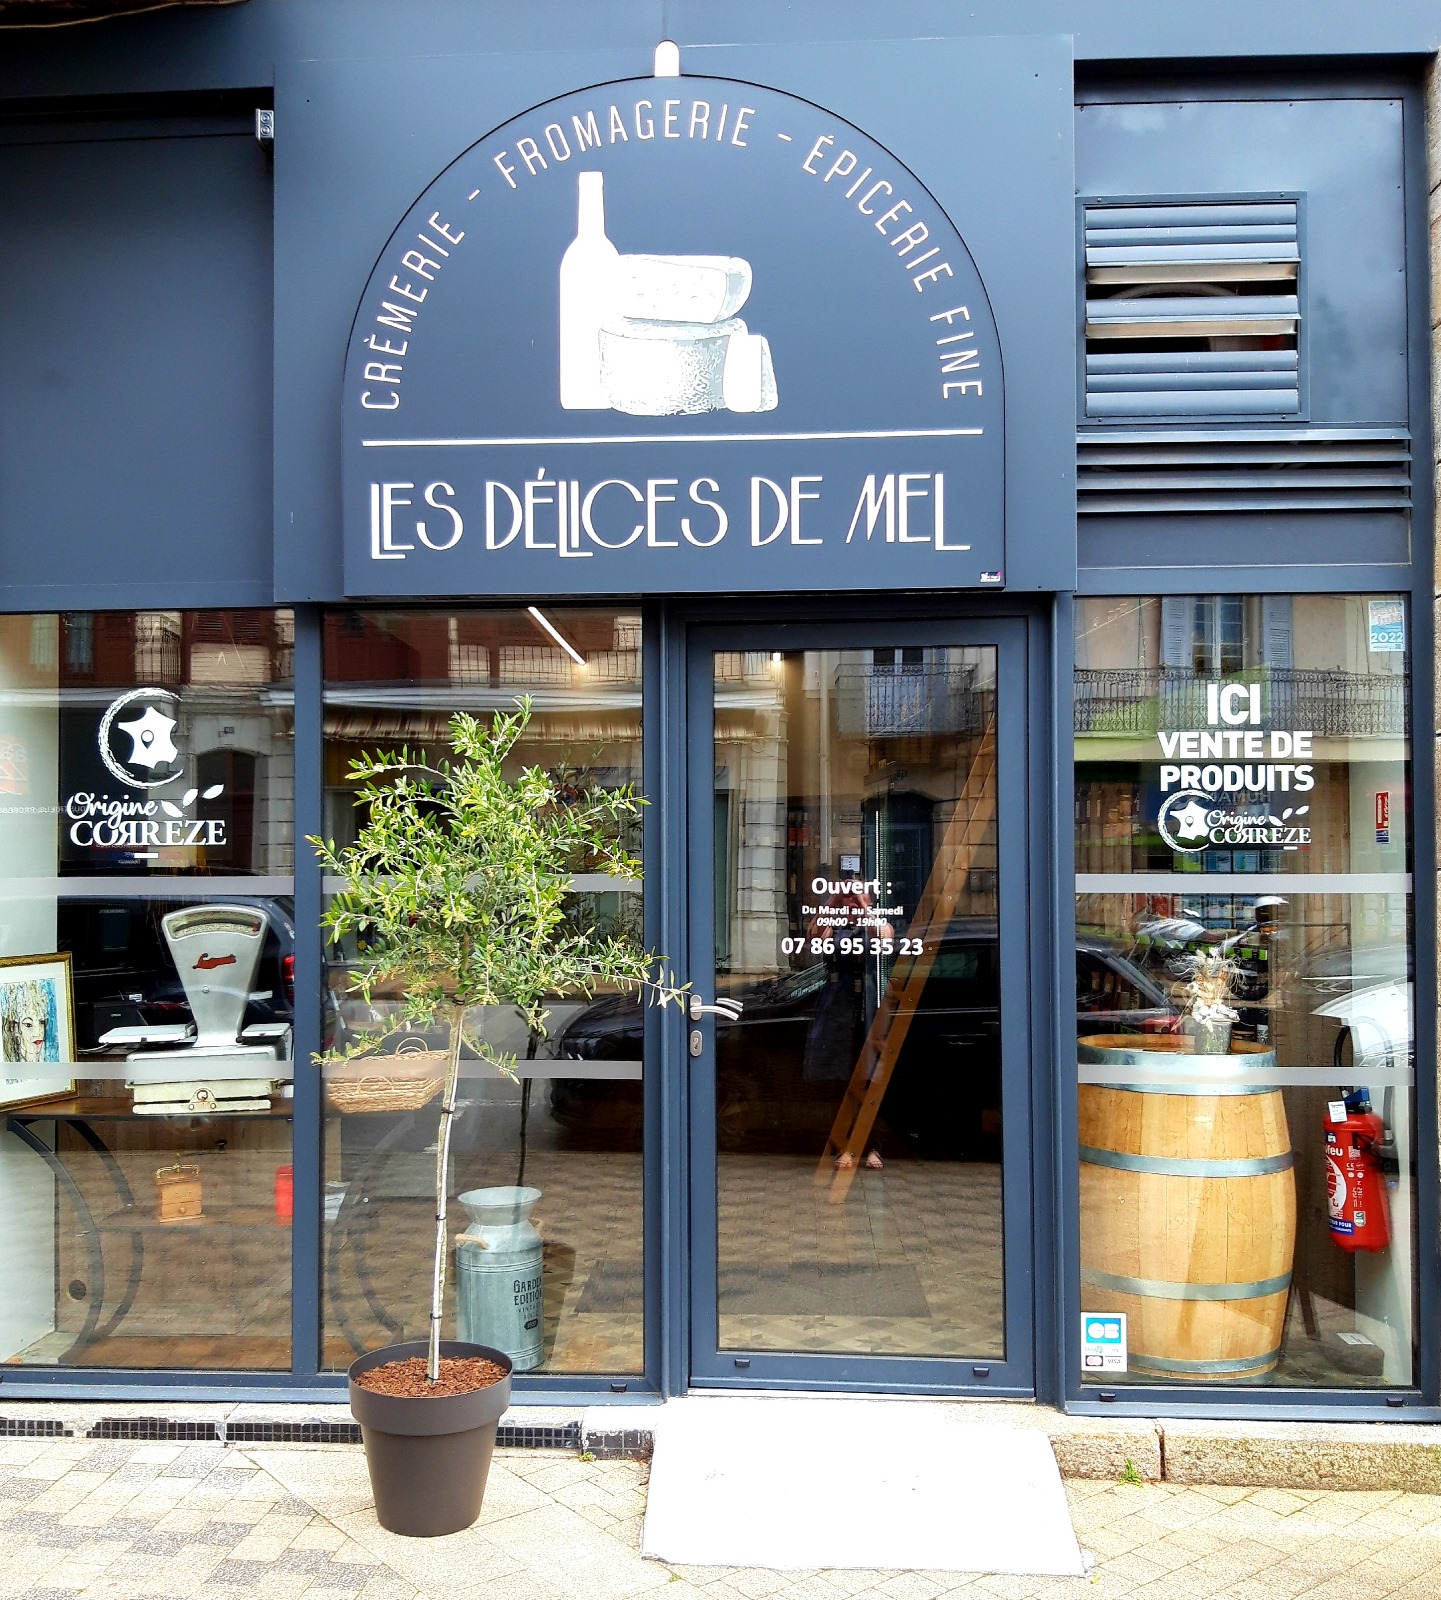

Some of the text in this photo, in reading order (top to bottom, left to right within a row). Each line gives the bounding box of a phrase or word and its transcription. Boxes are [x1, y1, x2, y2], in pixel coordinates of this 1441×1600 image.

[361, 211, 465, 410] CRÈMERIE
[493, 100, 756, 189] FROMAGERIE
[802, 134, 954, 293] ÉPICERIE
[929, 306, 983, 399] FINE
[371, 467, 971, 560] LES DÉLICES DE MEL
[1371, 631, 1403, 643] 2022
[1206, 683, 1261, 725] ICI
[1157, 730, 1313, 759] VENTE DE
[1160, 764, 1315, 792] PRODUITS
[66, 791, 159, 830] Origine
[1206, 809, 1267, 833] Origine
[811, 877, 881, 895] Ouvert
[801, 905, 817, 915] Du
[818, 905, 850, 915] Mardi
[866, 905, 904, 916] Samedi
[816, 917, 848, 927] 09h00
[855, 917, 888, 927] 19h00
[781, 937, 924, 955] 07 86 95 35 23
